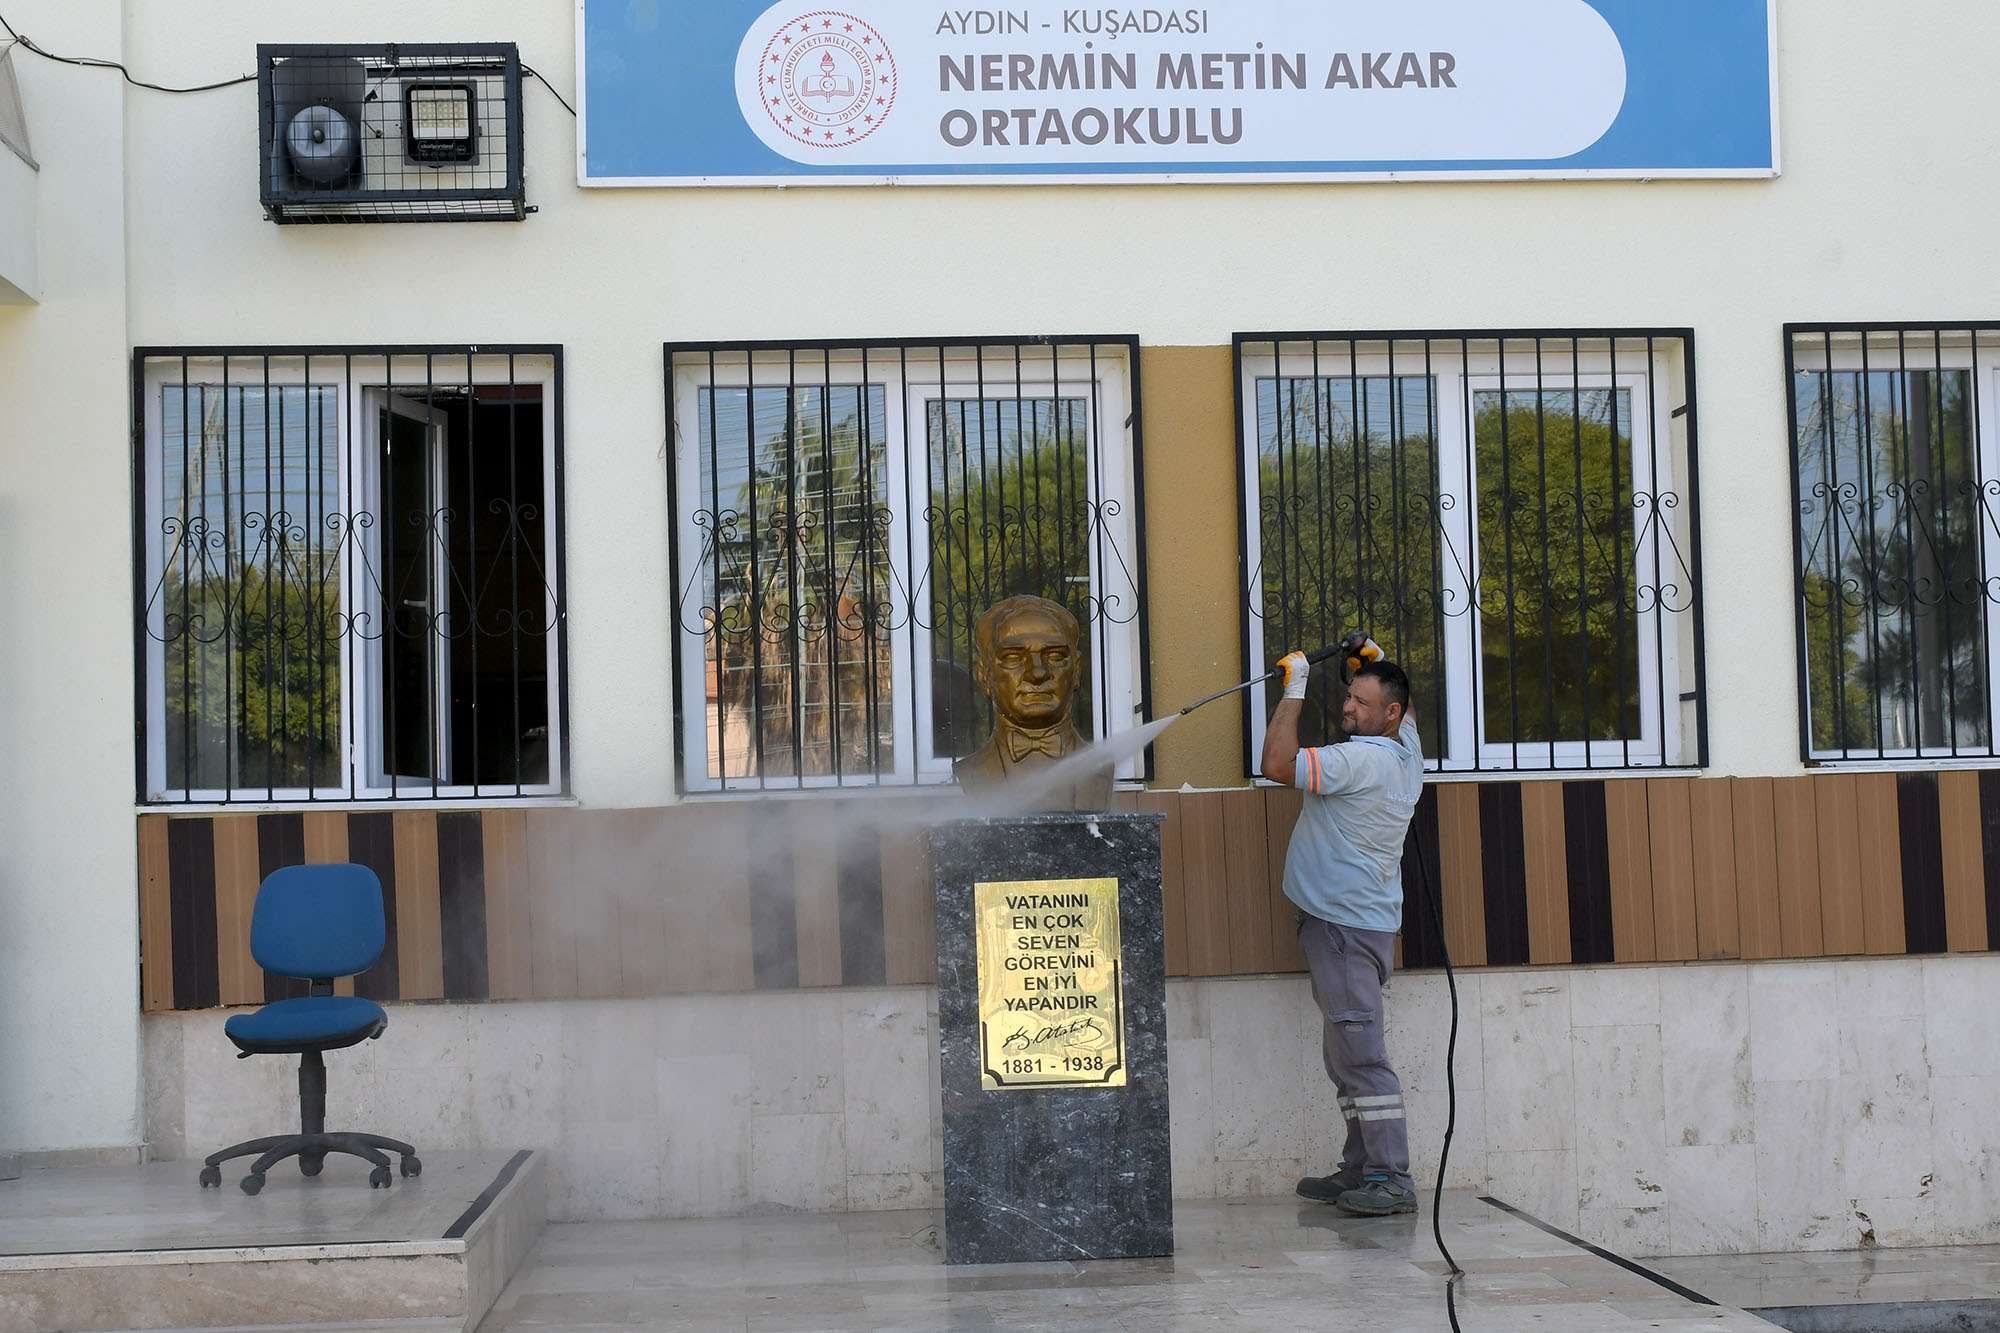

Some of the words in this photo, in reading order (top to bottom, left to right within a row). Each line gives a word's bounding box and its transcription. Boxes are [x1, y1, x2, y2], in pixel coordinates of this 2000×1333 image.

[936, 10, 1029, 35] AYDIN
[1062, 9, 1208, 39] KUŞADASI
[824, 36, 850, 49] MİLLİ
[784, 36, 822, 89] CUMHURİYETİ
[850, 46, 871, 77] EĞİTİM
[939, 41, 1136, 91] NERMİN
[1156, 41, 1306, 90] METİN
[1324, 51, 1457, 89] AKAR
[788, 92, 819, 121] TÜRKİYE
[838, 79, 871, 121] BAKANLIĞI
[939, 107, 1243, 147] ORTAOKULU
[1006, 894, 1089, 909] VATANINI
[1012, 915, 1037, 930] EN
[1043, 914, 1084, 932] ÇOK
[1017, 934, 1080, 950] SEVEN
[1004, 951, 1095, 970] GÖREVİNİ
[1024, 976, 1049, 991] EN
[1054, 972, 1077, 990] İYİ
[1003, 995, 1098, 1011] YAPANDIR
[1002, 1059, 1043, 1074] 1881
[1062, 1056, 1104, 1072] 1938
